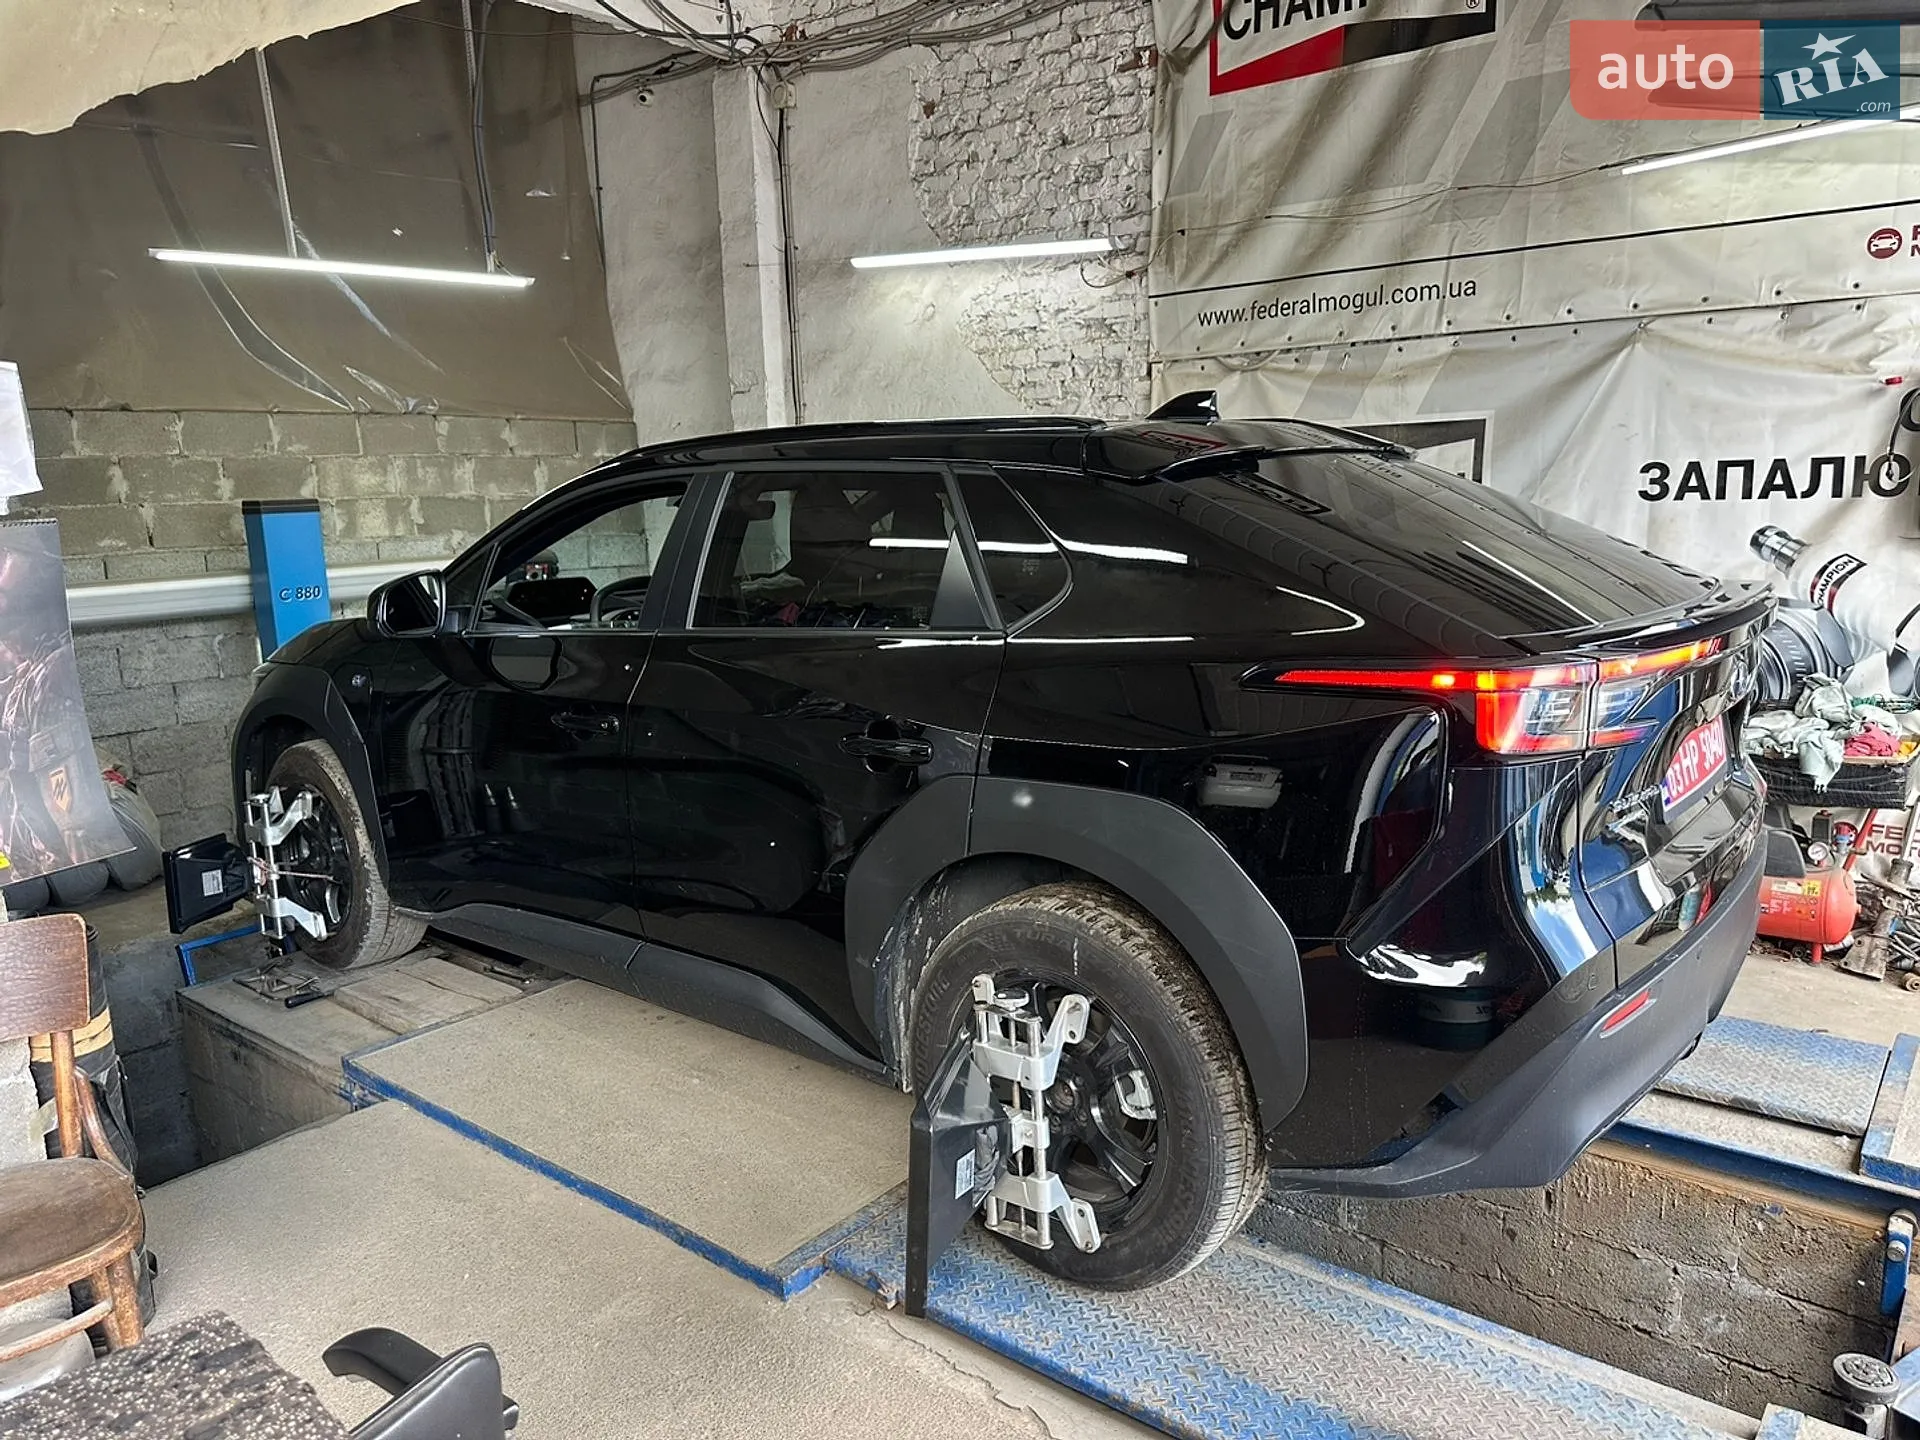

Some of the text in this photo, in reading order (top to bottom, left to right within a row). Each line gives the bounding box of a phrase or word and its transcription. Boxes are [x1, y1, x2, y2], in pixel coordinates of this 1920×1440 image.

[1198, 280, 1477, 327] www.federalmogul.com.ua
[1638, 454, 1920, 501] ЗАПАЛЮ
[279, 585, 322, 602] C 880
